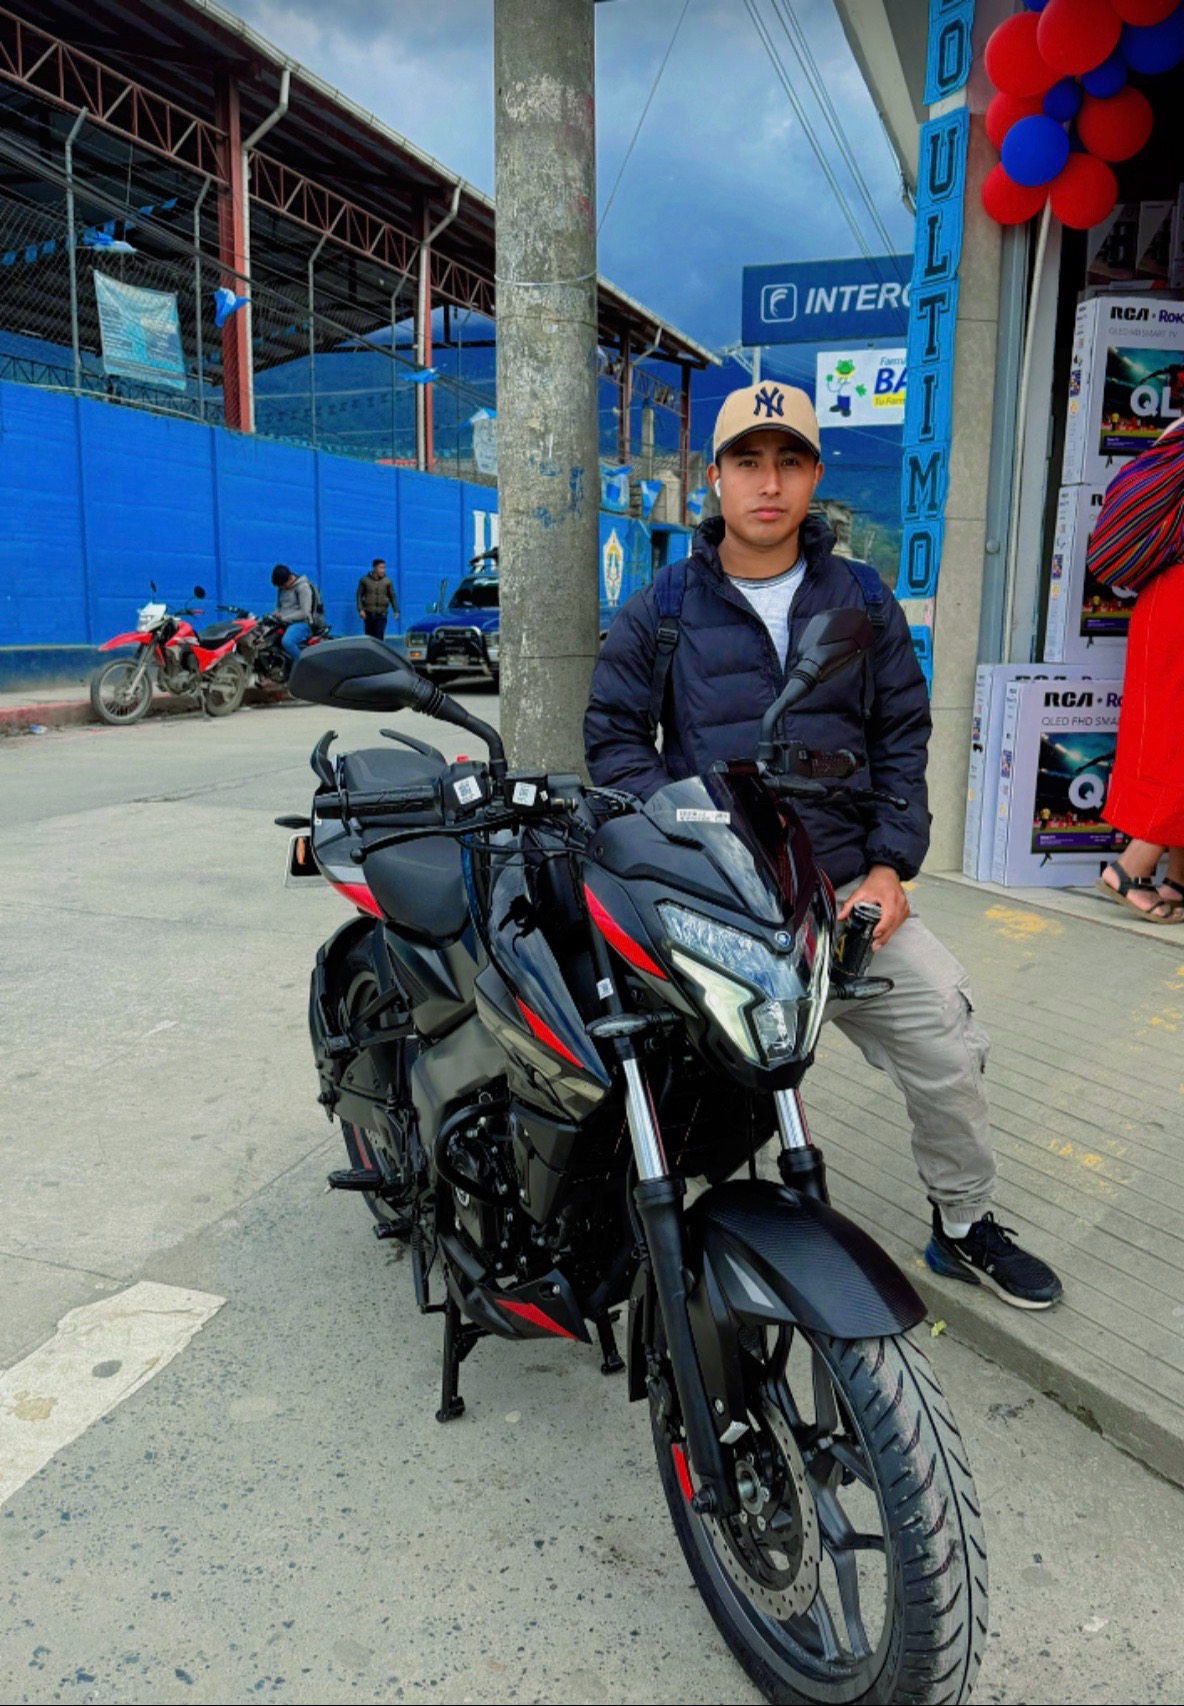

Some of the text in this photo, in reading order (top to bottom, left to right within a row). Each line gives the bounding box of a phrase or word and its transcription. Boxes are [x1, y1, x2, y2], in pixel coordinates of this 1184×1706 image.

[1109, 306, 1149, 321] RCA
[1141, 328, 1166, 338] SMART
[1168, 330, 1179, 338] TV
[753, 386, 784, 418] NY
[1043, 691, 1094, 708] RCA
[1041, 716, 1069, 727] QLED
[1071, 716, 1093, 727] FHD
